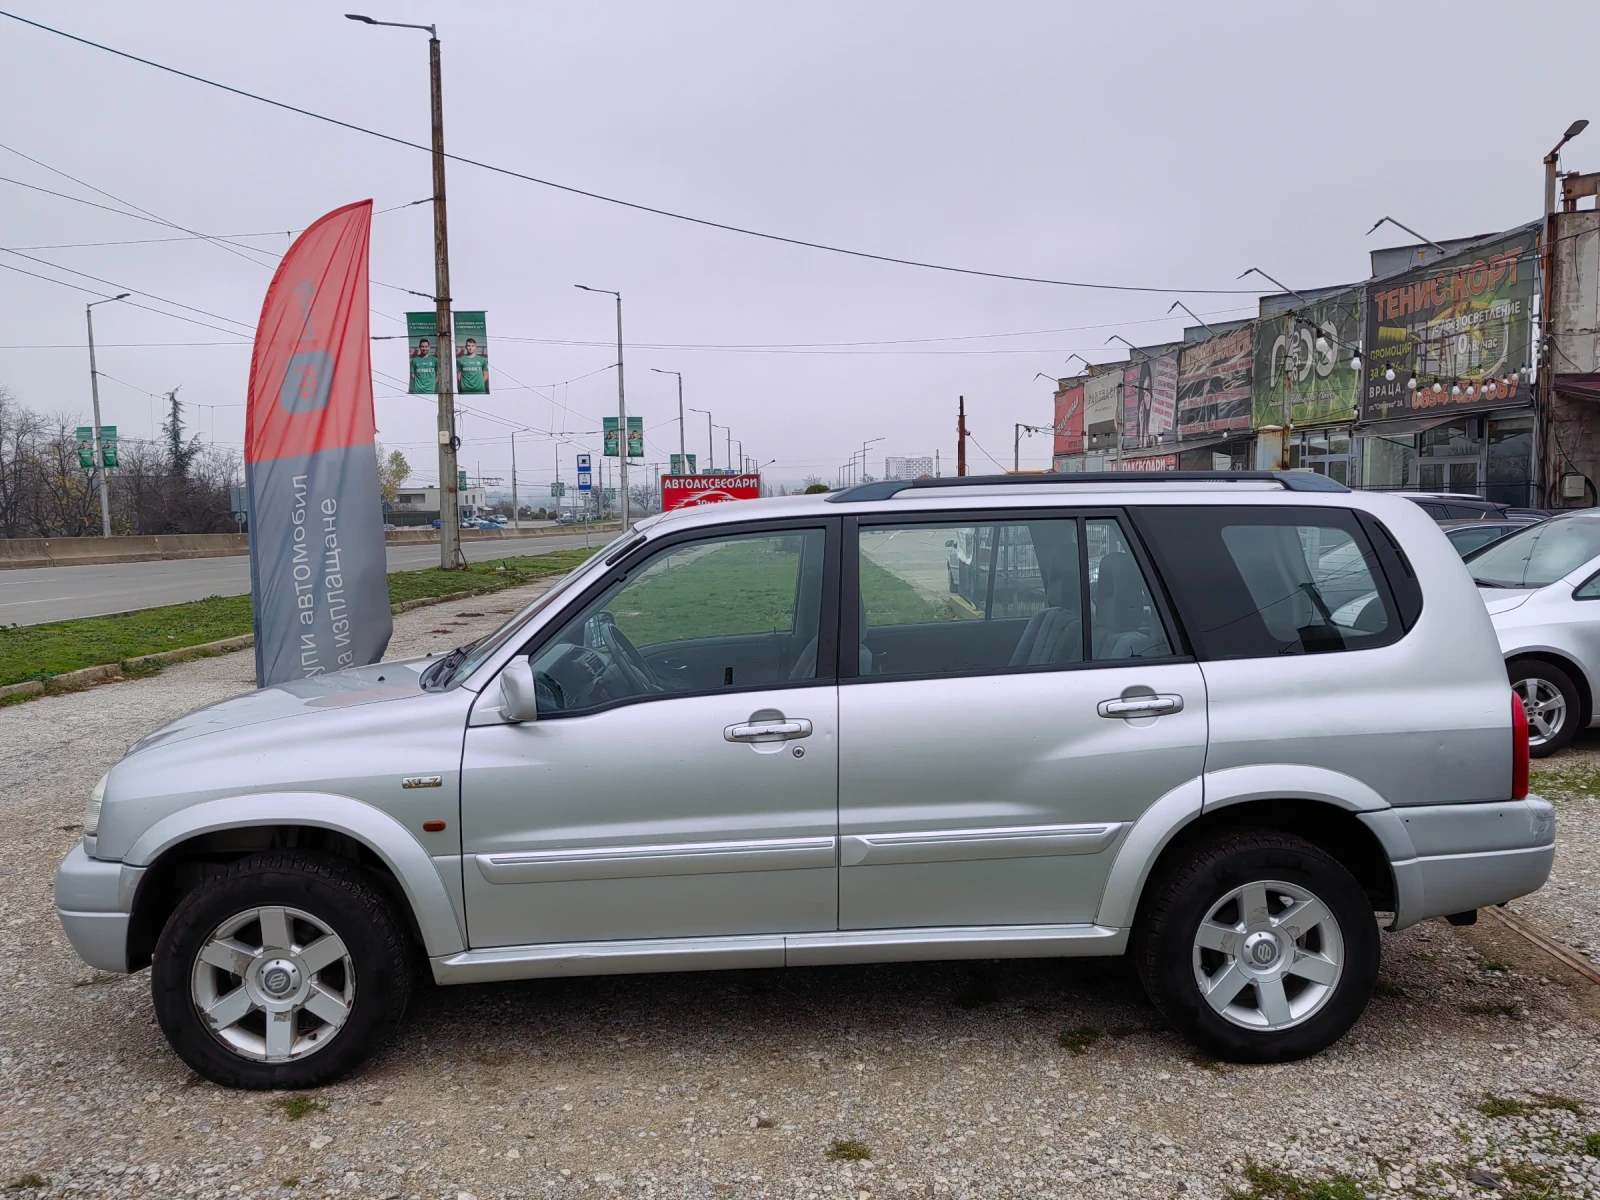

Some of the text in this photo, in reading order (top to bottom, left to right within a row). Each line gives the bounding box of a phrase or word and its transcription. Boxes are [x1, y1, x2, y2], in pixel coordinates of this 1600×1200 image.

[1374, 246, 1523, 322] ТЕНИС КОРТ
[1461, 301, 1521, 327] ОСВЕТЛЕНИЕ
[1371, 342, 1412, 359] ПРОМОЦИЯ
[1369, 383, 1405, 398] ВРАЦА,
[664, 478, 757, 489] АВТОАКСЕСОАРИ
[292, 474, 325, 679] упи автомобил
[321, 498, 351, 648] изплащане
